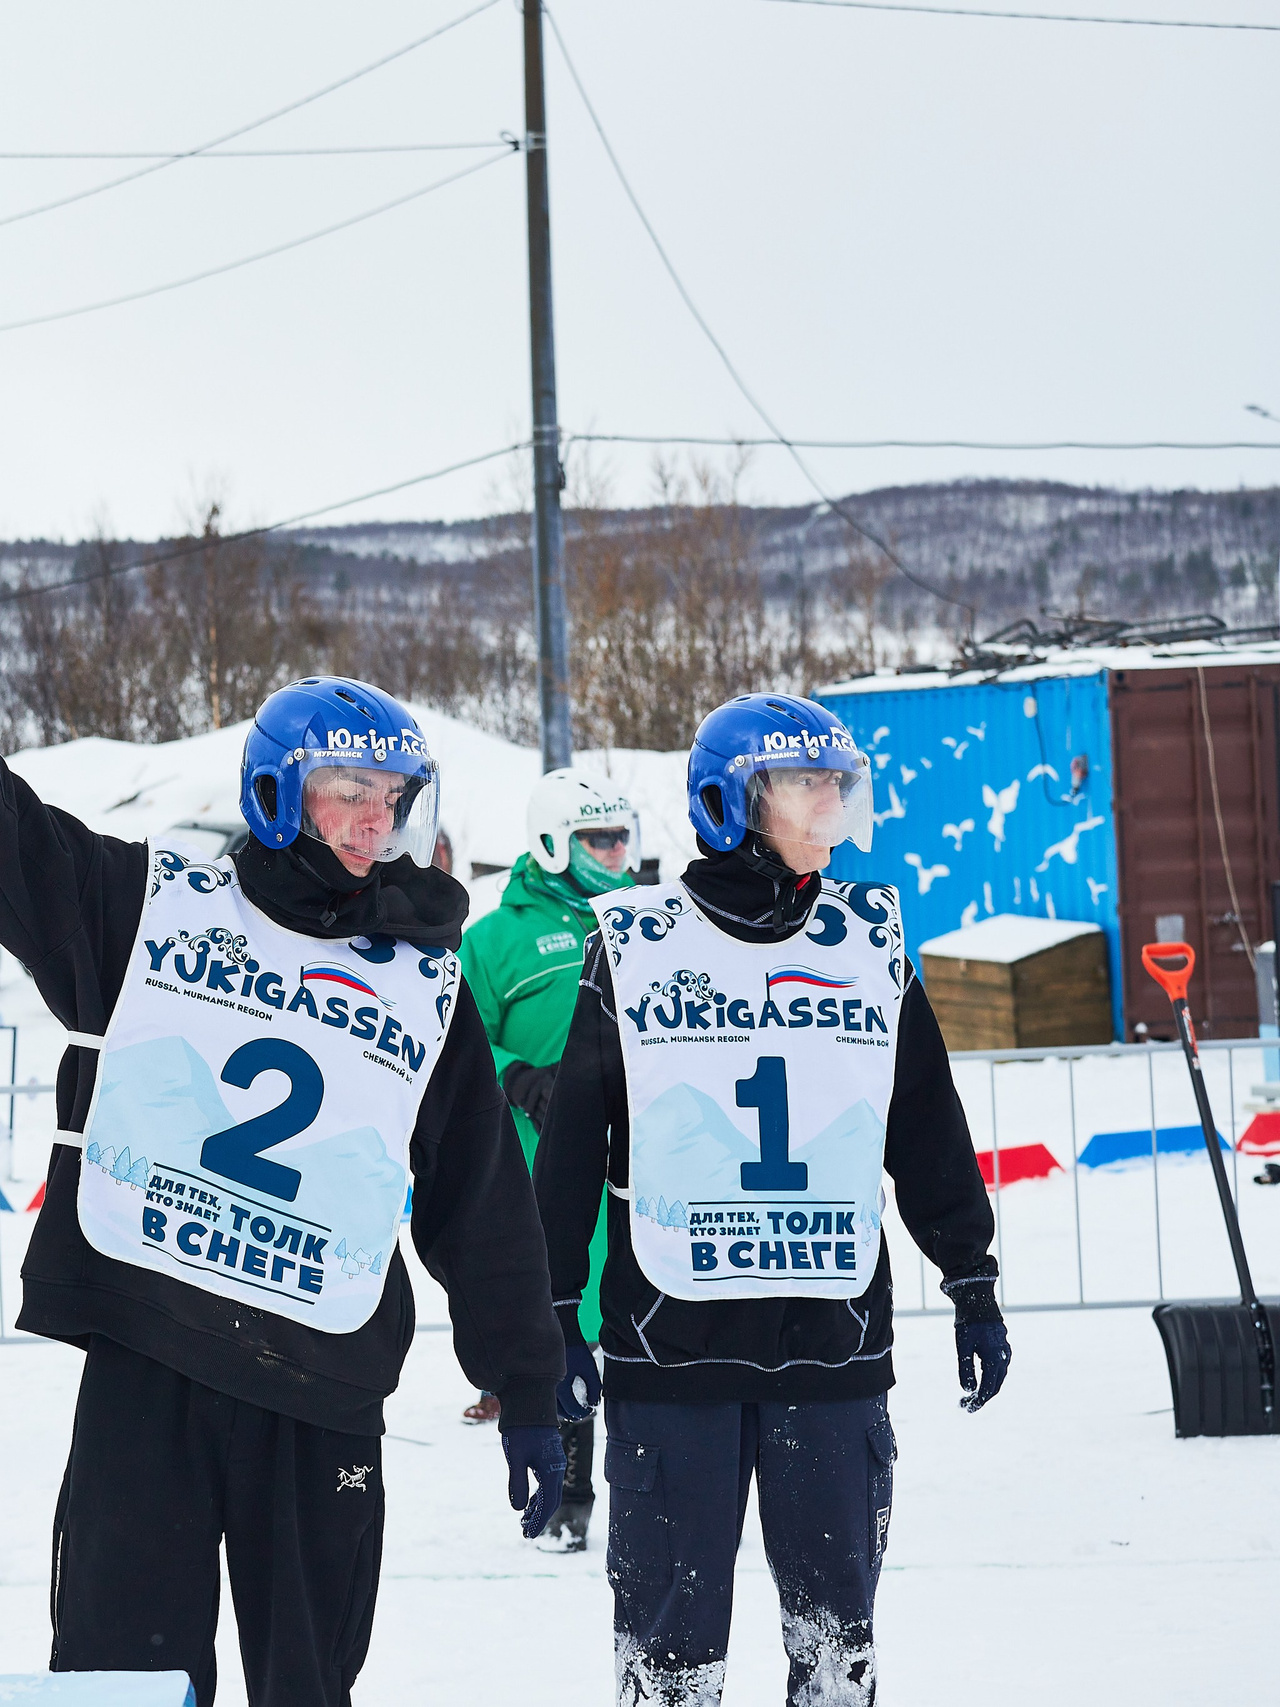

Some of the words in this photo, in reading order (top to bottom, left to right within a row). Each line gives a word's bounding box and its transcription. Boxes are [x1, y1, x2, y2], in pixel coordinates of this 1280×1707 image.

[313, 750, 363, 759] МУРМАНСК
[754, 751, 800, 763] МУРМАНСК
[183, 988, 236, 1010] MURMANSK
[236, 1003, 273, 1021] REGION
[670, 1035, 716, 1044] MURMANSK
[717, 1035, 751, 1043] REGION
[835, 1035, 876, 1047] СНЕЖНЫЙ
[362, 1050, 406, 1079] СНЕЖНЫЙ
[199, 1037, 325, 1203] 2
[735, 1056, 809, 1192] 1
[145, 1190, 174, 1207] КТО
[174, 1200, 220, 1223] ЗНАЕТ
[148, 1174, 186, 1196] ДЛЯ
[188, 1186, 222, 1211] ТЕХ,
[229, 1203, 329, 1265] ТОЛК
[689, 1212, 724, 1226] ДЛЯ
[726, 1212, 761, 1224] ТЕХ,
[689, 1227, 717, 1237] КТО
[719, 1226, 761, 1236] ЗНАЕТ
[766, 1211, 856, 1235] ТОЛК
[142, 1206, 168, 1243] В
[176, 1221, 325, 1295] СНЕГЕ
[690, 1241, 719, 1272] В
[727, 1240, 857, 1271] СНЕГЕ
